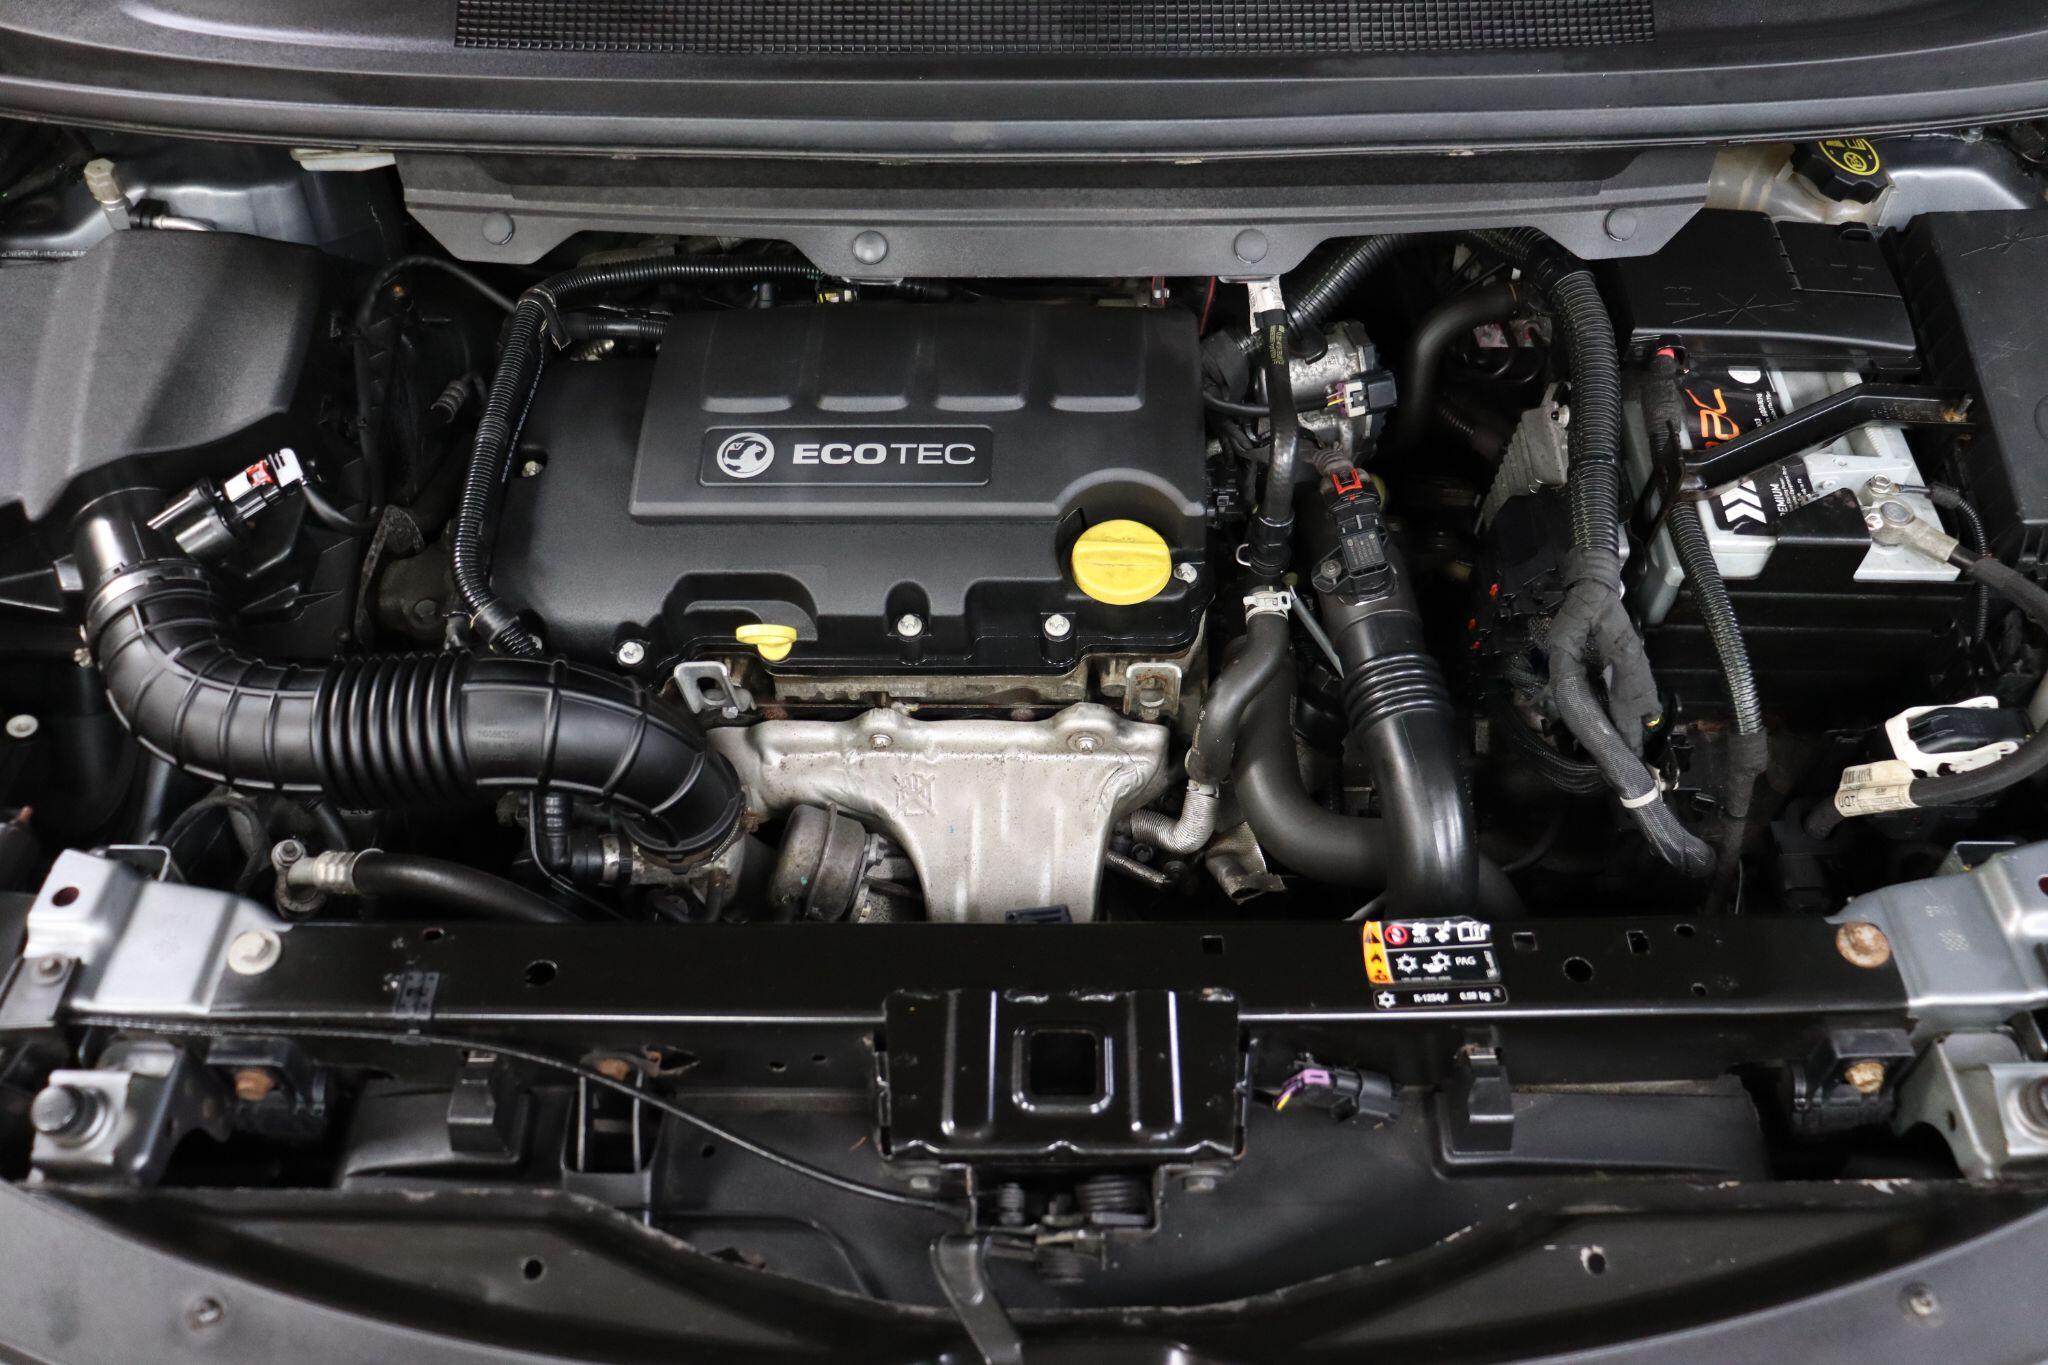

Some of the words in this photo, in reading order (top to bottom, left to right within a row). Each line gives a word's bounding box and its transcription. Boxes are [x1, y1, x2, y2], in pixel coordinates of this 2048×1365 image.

[793, 443, 976, 465] ECOTEC
[1769, 483, 1789, 517] EMIUM
[1413, 935, 1431, 944] AUTO
[1455, 956, 1477, 966] PAG
[1478, 990, 1492, 1002] kg
